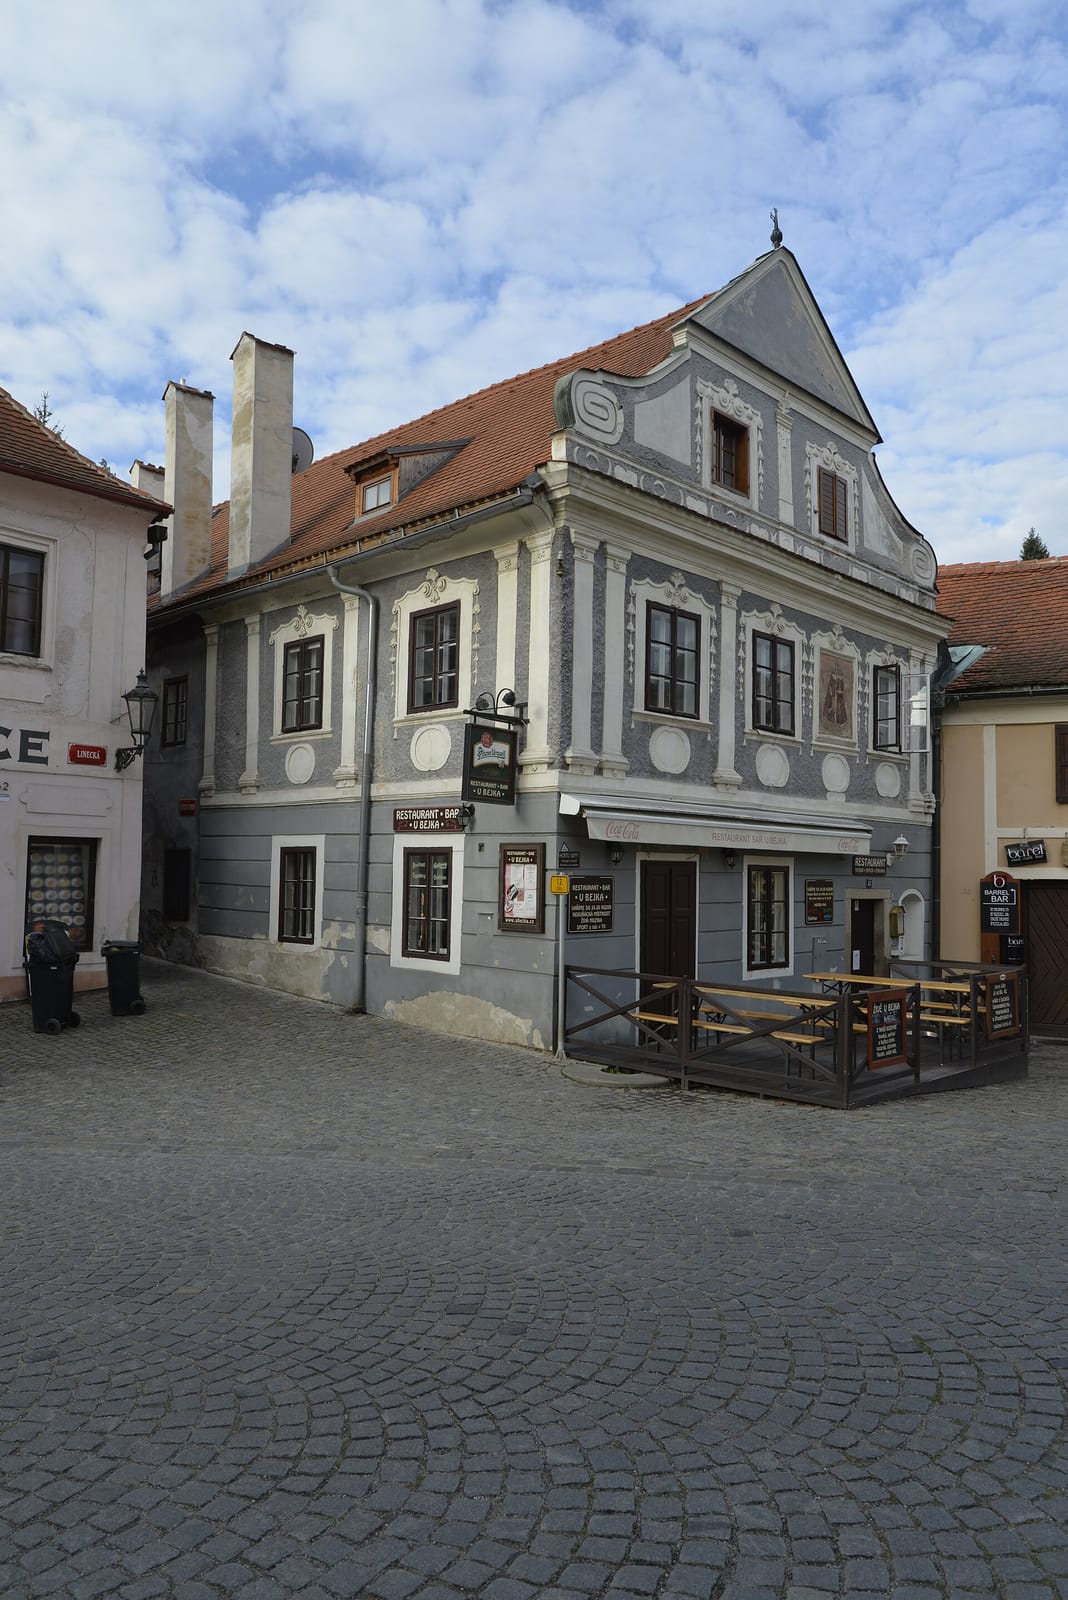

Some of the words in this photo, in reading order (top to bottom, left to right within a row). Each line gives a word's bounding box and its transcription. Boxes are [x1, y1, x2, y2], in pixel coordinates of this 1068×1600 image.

[76, 749, 101, 760] LINECKÁ
[470, 780, 497, 788] RESTAURANT
[483, 789, 501, 798] BEJKA
[396, 809, 440, 820] RESTAURANT
[444, 808, 460, 819] BAR
[413, 820, 419, 830] U
[419, 820, 440, 830] BEJKA
[711, 832, 750, 843] RESTAURANT
[751, 833, 764, 843] BAR
[764, 834, 770, 844] U
[769, 835, 787, 845] BEJKA
[855, 857, 886, 868] RESTAURANT
[579, 893, 584, 902] U
[585, 893, 604, 901] BEJKA
[991, 895, 1009, 903] BAR
